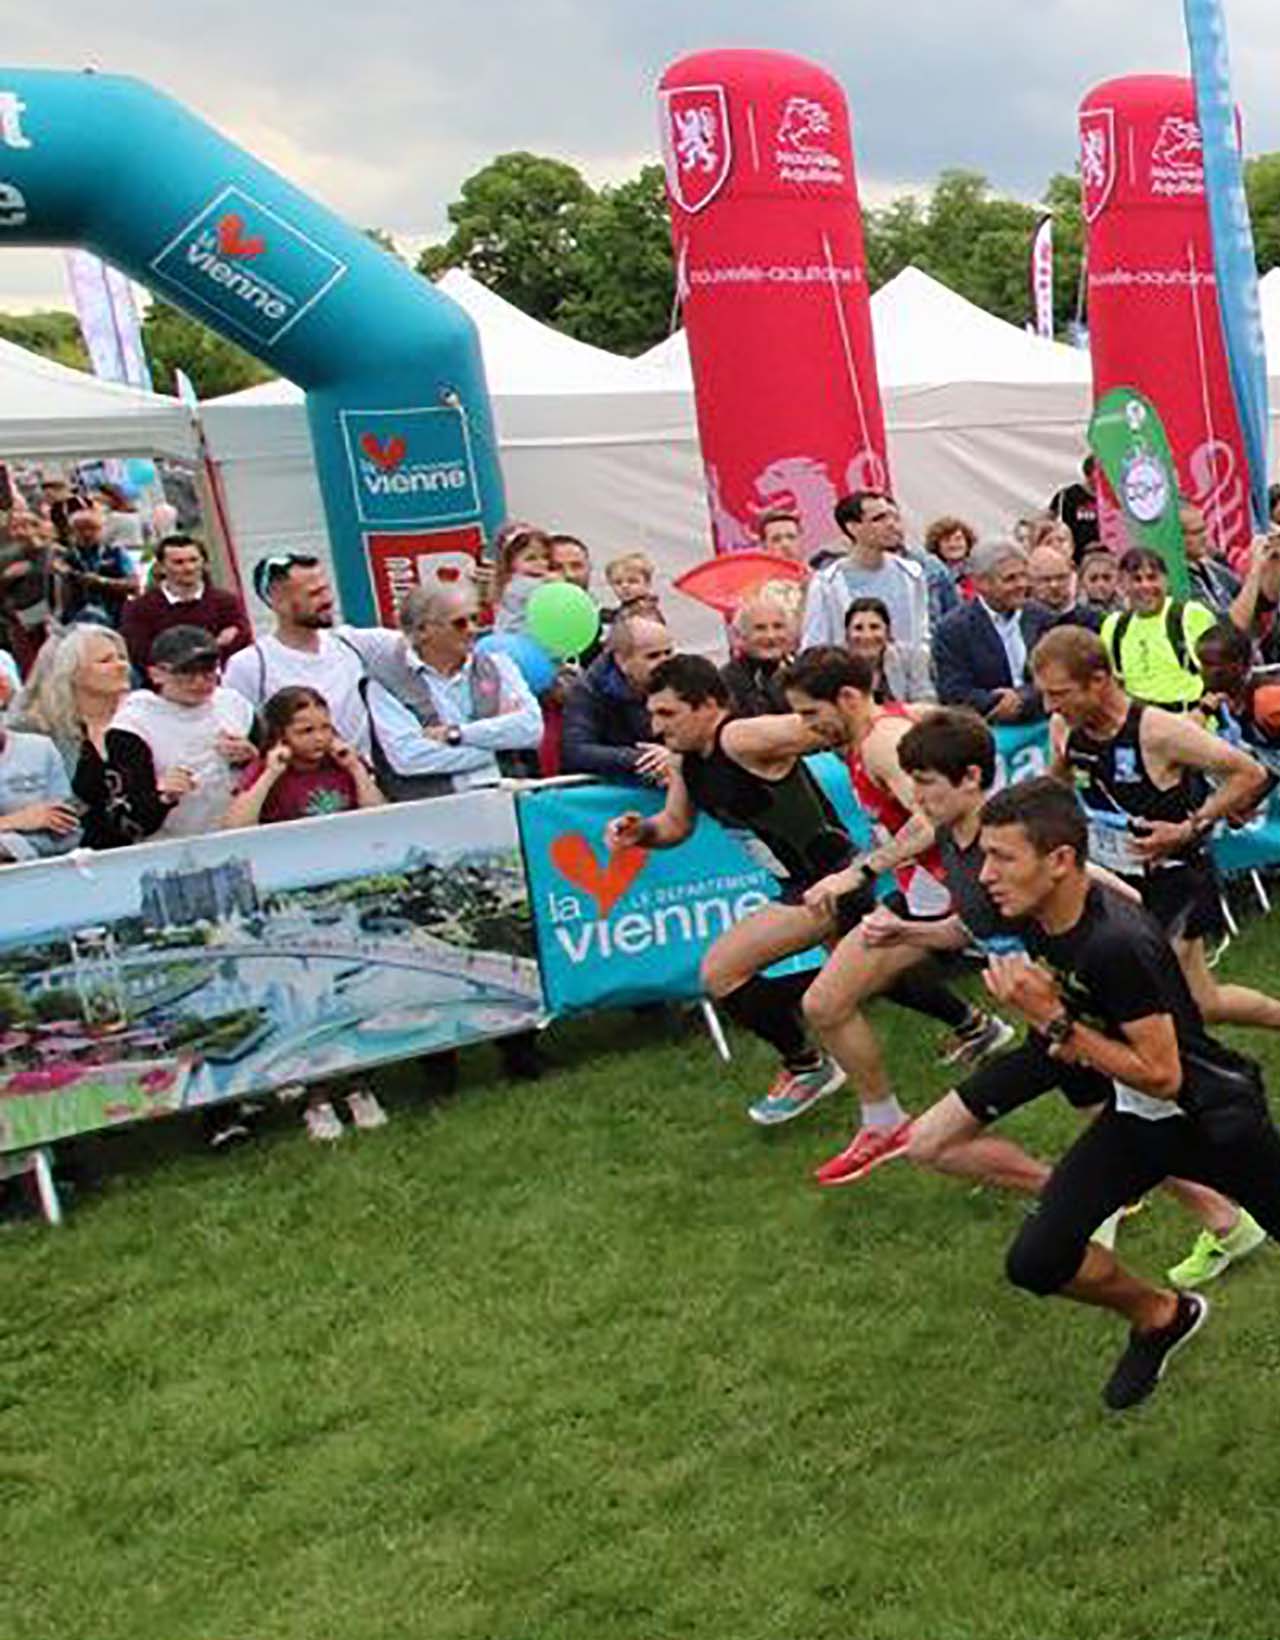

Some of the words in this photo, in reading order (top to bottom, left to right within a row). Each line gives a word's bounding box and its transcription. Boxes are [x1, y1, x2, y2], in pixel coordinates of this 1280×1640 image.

[186, 241, 287, 320] vienne
[364, 470, 467, 495] vienne
[548, 891, 581, 922] la
[555, 889, 770, 963] vienne
